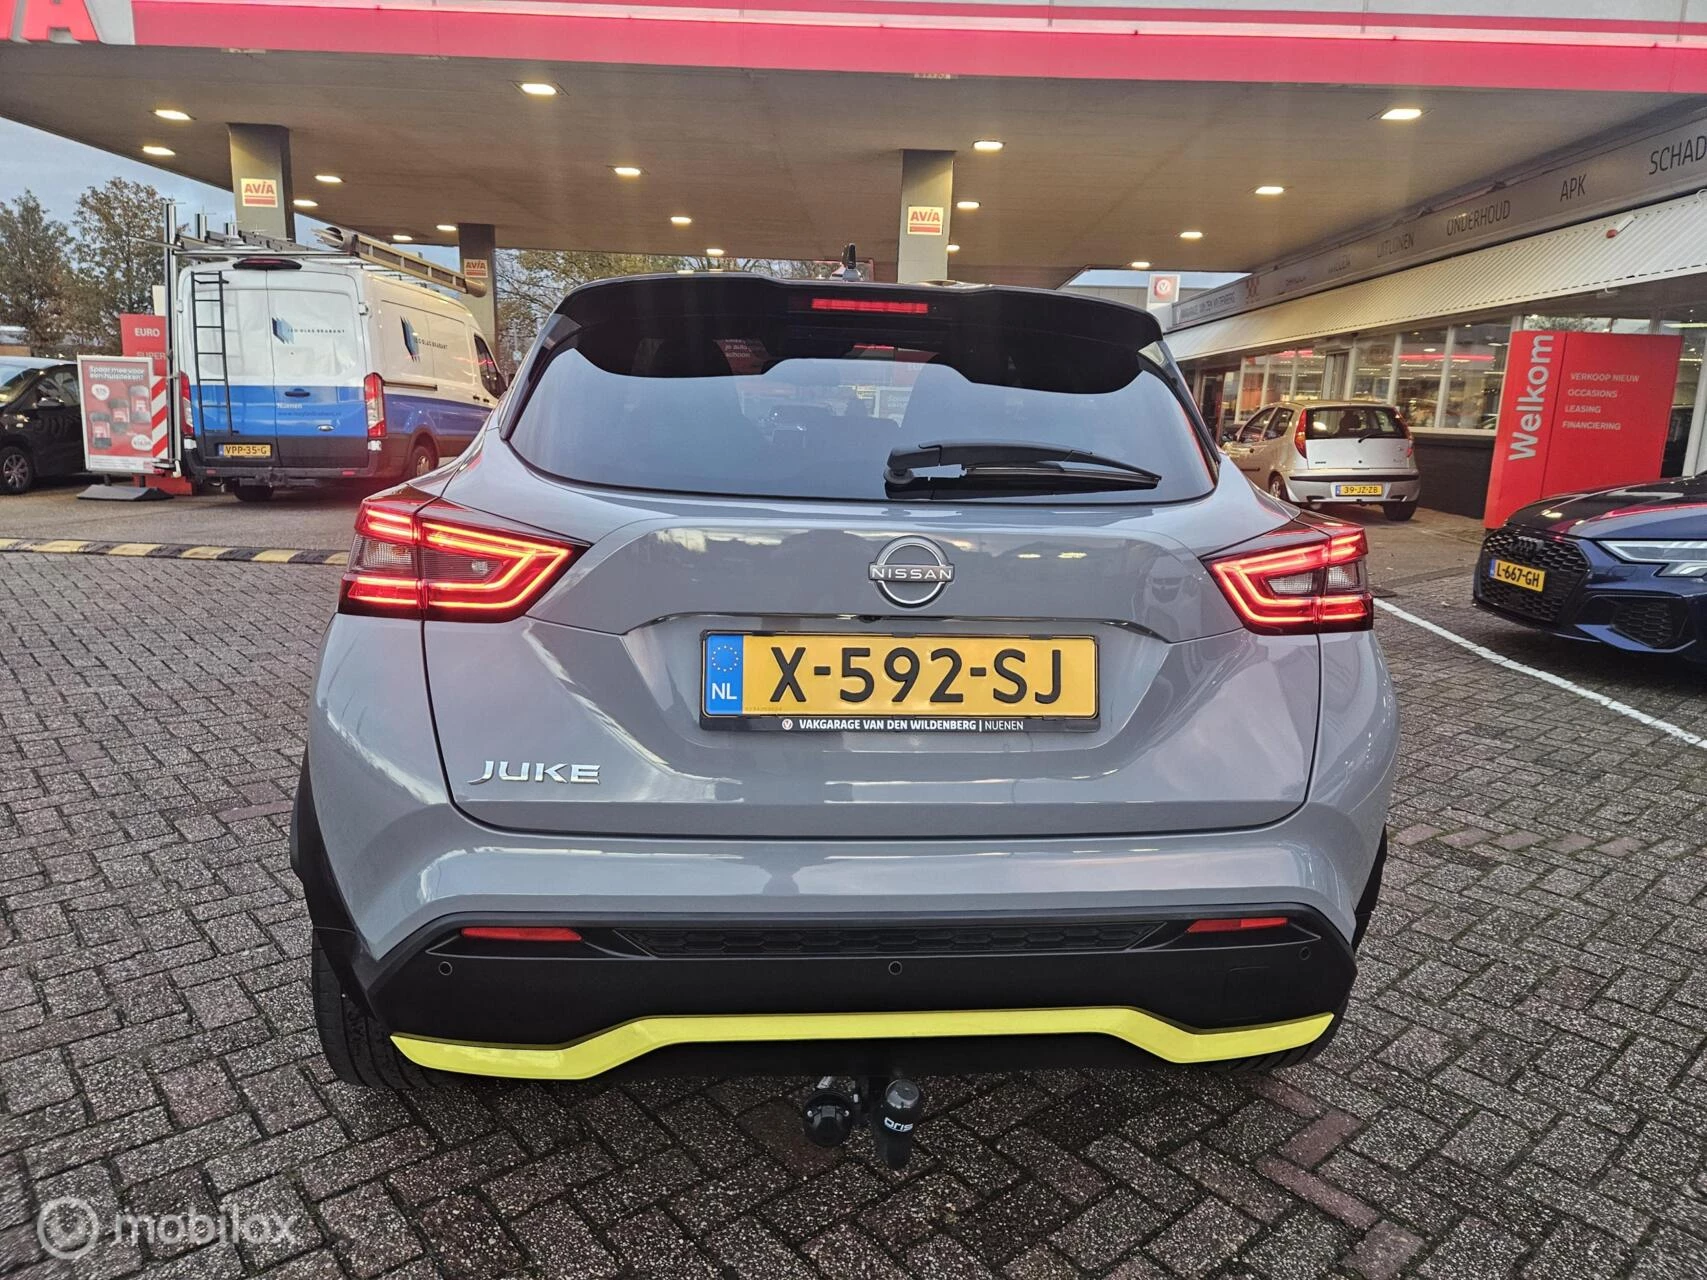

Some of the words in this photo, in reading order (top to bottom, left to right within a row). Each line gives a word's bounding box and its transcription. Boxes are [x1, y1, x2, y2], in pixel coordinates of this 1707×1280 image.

[244, 181, 275, 194] AVIA
[1560, 174, 1586, 202] APK
[910, 209, 940, 222] AVIA
[1447, 200, 1511, 236] ONDERHOUD
[134, 328, 161, 337] EURO
[1570, 373, 1611, 381] VERKOOP
[1612, 374, 1640, 382] NIEUW
[1508, 334, 1554, 460] Welkom
[1568, 389, 1617, 398] OCCASIONS
[1562, 421, 1621, 430] FINANCIERING
[225, 446, 267, 455] VPP-35-G
[1344, 486, 1378, 494] 39-JZ-ZB
[872, 567, 952, 580] NISSAN
[1497, 562, 1540, 588] L-667-GH
[770, 647, 1062, 704] X-592-SJ
[711, 683, 738, 701] NL
[799, 719, 860, 730] VAKGARAGE
[863, 719, 884, 730] VAN
[887, 719, 907, 730] DEN
[910, 720, 976, 730] WILDENBERG
[985, 720, 1024, 731] NUENEN
[467, 760, 600, 785] JUKE
